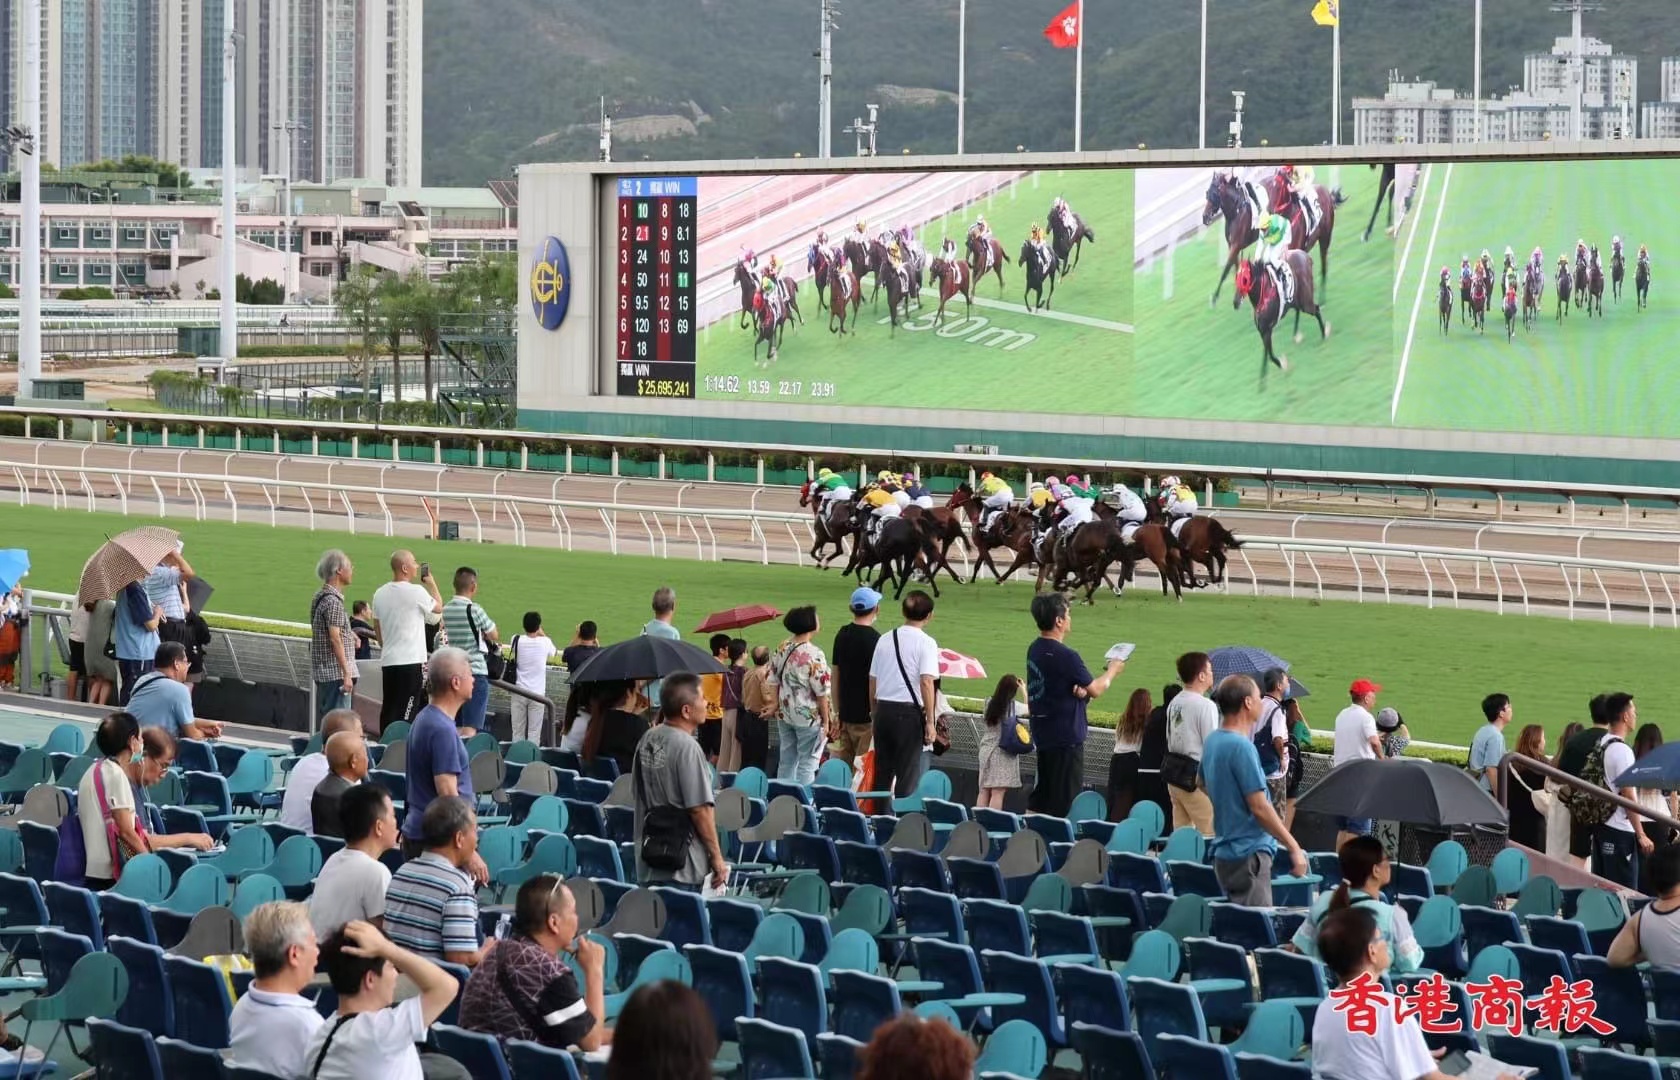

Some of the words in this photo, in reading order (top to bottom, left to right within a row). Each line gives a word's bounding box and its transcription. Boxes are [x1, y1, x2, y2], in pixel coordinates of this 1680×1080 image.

[636, 181, 642, 196] 2
[664, 181, 680, 194] WIN
[622, 203, 627, 218] 1
[638, 203, 648, 218] 10
[662, 203, 668, 218] 8
[679, 203, 689, 218] 18
[622, 226, 628, 240] 2
[636, 226, 649, 240] 2.1
[662, 226, 668, 240] 9
[677, 226, 689, 240] 8.1
[622, 250, 628, 264] 3
[637, 250, 648, 264] 24
[660, 250, 670, 264] 10
[679, 250, 689, 264] 13
[621, 272, 628, 287] 4
[637, 272, 648, 287] 50
[660, 272, 669, 287] 11
[678, 272, 689, 287] 11
[621, 296, 627, 310] 5
[636, 296, 648, 310] 9.5
[660, 296, 670, 310] 12
[678, 296, 688, 310] 15
[621, 318, 627, 333] 6
[635, 318, 650, 333] 120
[659, 318, 670, 333] 13
[678, 318, 688, 333] 69
[620, 340, 626, 356] 7
[636, 340, 647, 356] 18
[635, 364, 650, 376] WIN
[638, 378, 644, 396] $
[645, 380, 689, 396] 25,695,241
[704, 375, 740, 392] 1:14.62
[748, 380, 770, 394] 13.59
[778, 381, 802, 396] 22.17
[811, 382, 834, 397] 23.91
